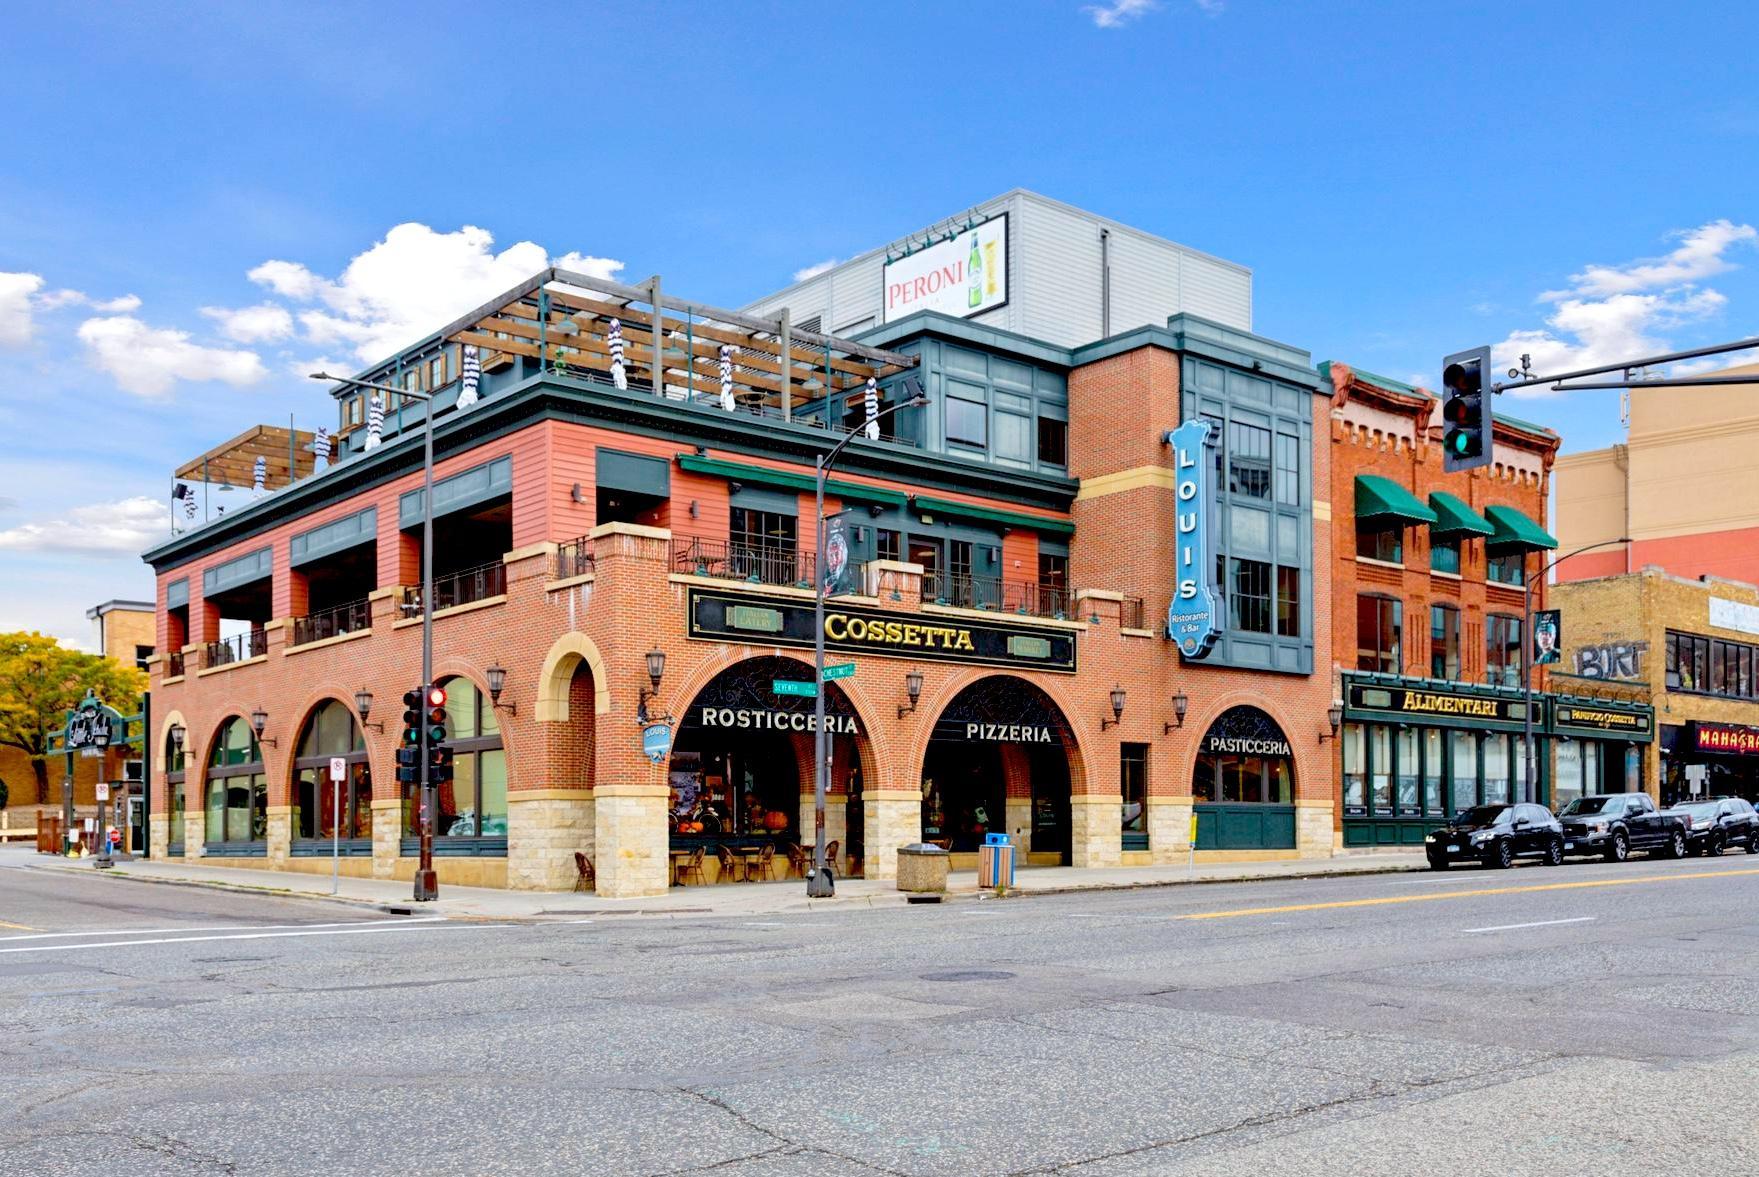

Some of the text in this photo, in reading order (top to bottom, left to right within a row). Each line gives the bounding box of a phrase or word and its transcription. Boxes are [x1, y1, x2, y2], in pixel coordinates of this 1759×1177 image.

[888, 260, 963, 310] PERONI
[1179, 448, 1198, 599] LOUIS
[1172, 611, 1209, 623] Ristorante
[825, 614, 975, 651] COSSETTA
[1187, 624, 1200, 632] Bar
[774, 683, 798, 692] SEVENTH
[1403, 692, 1498, 716] ALIMENTARI
[702, 707, 858, 734] ROSTICCERIA
[1604, 713, 1636, 725] COSSETTA
[645, 727, 666, 737] LOUIS
[966, 723, 1052, 743] PIZZERIA
[1211, 737, 1291, 755] PASTICCERIA
